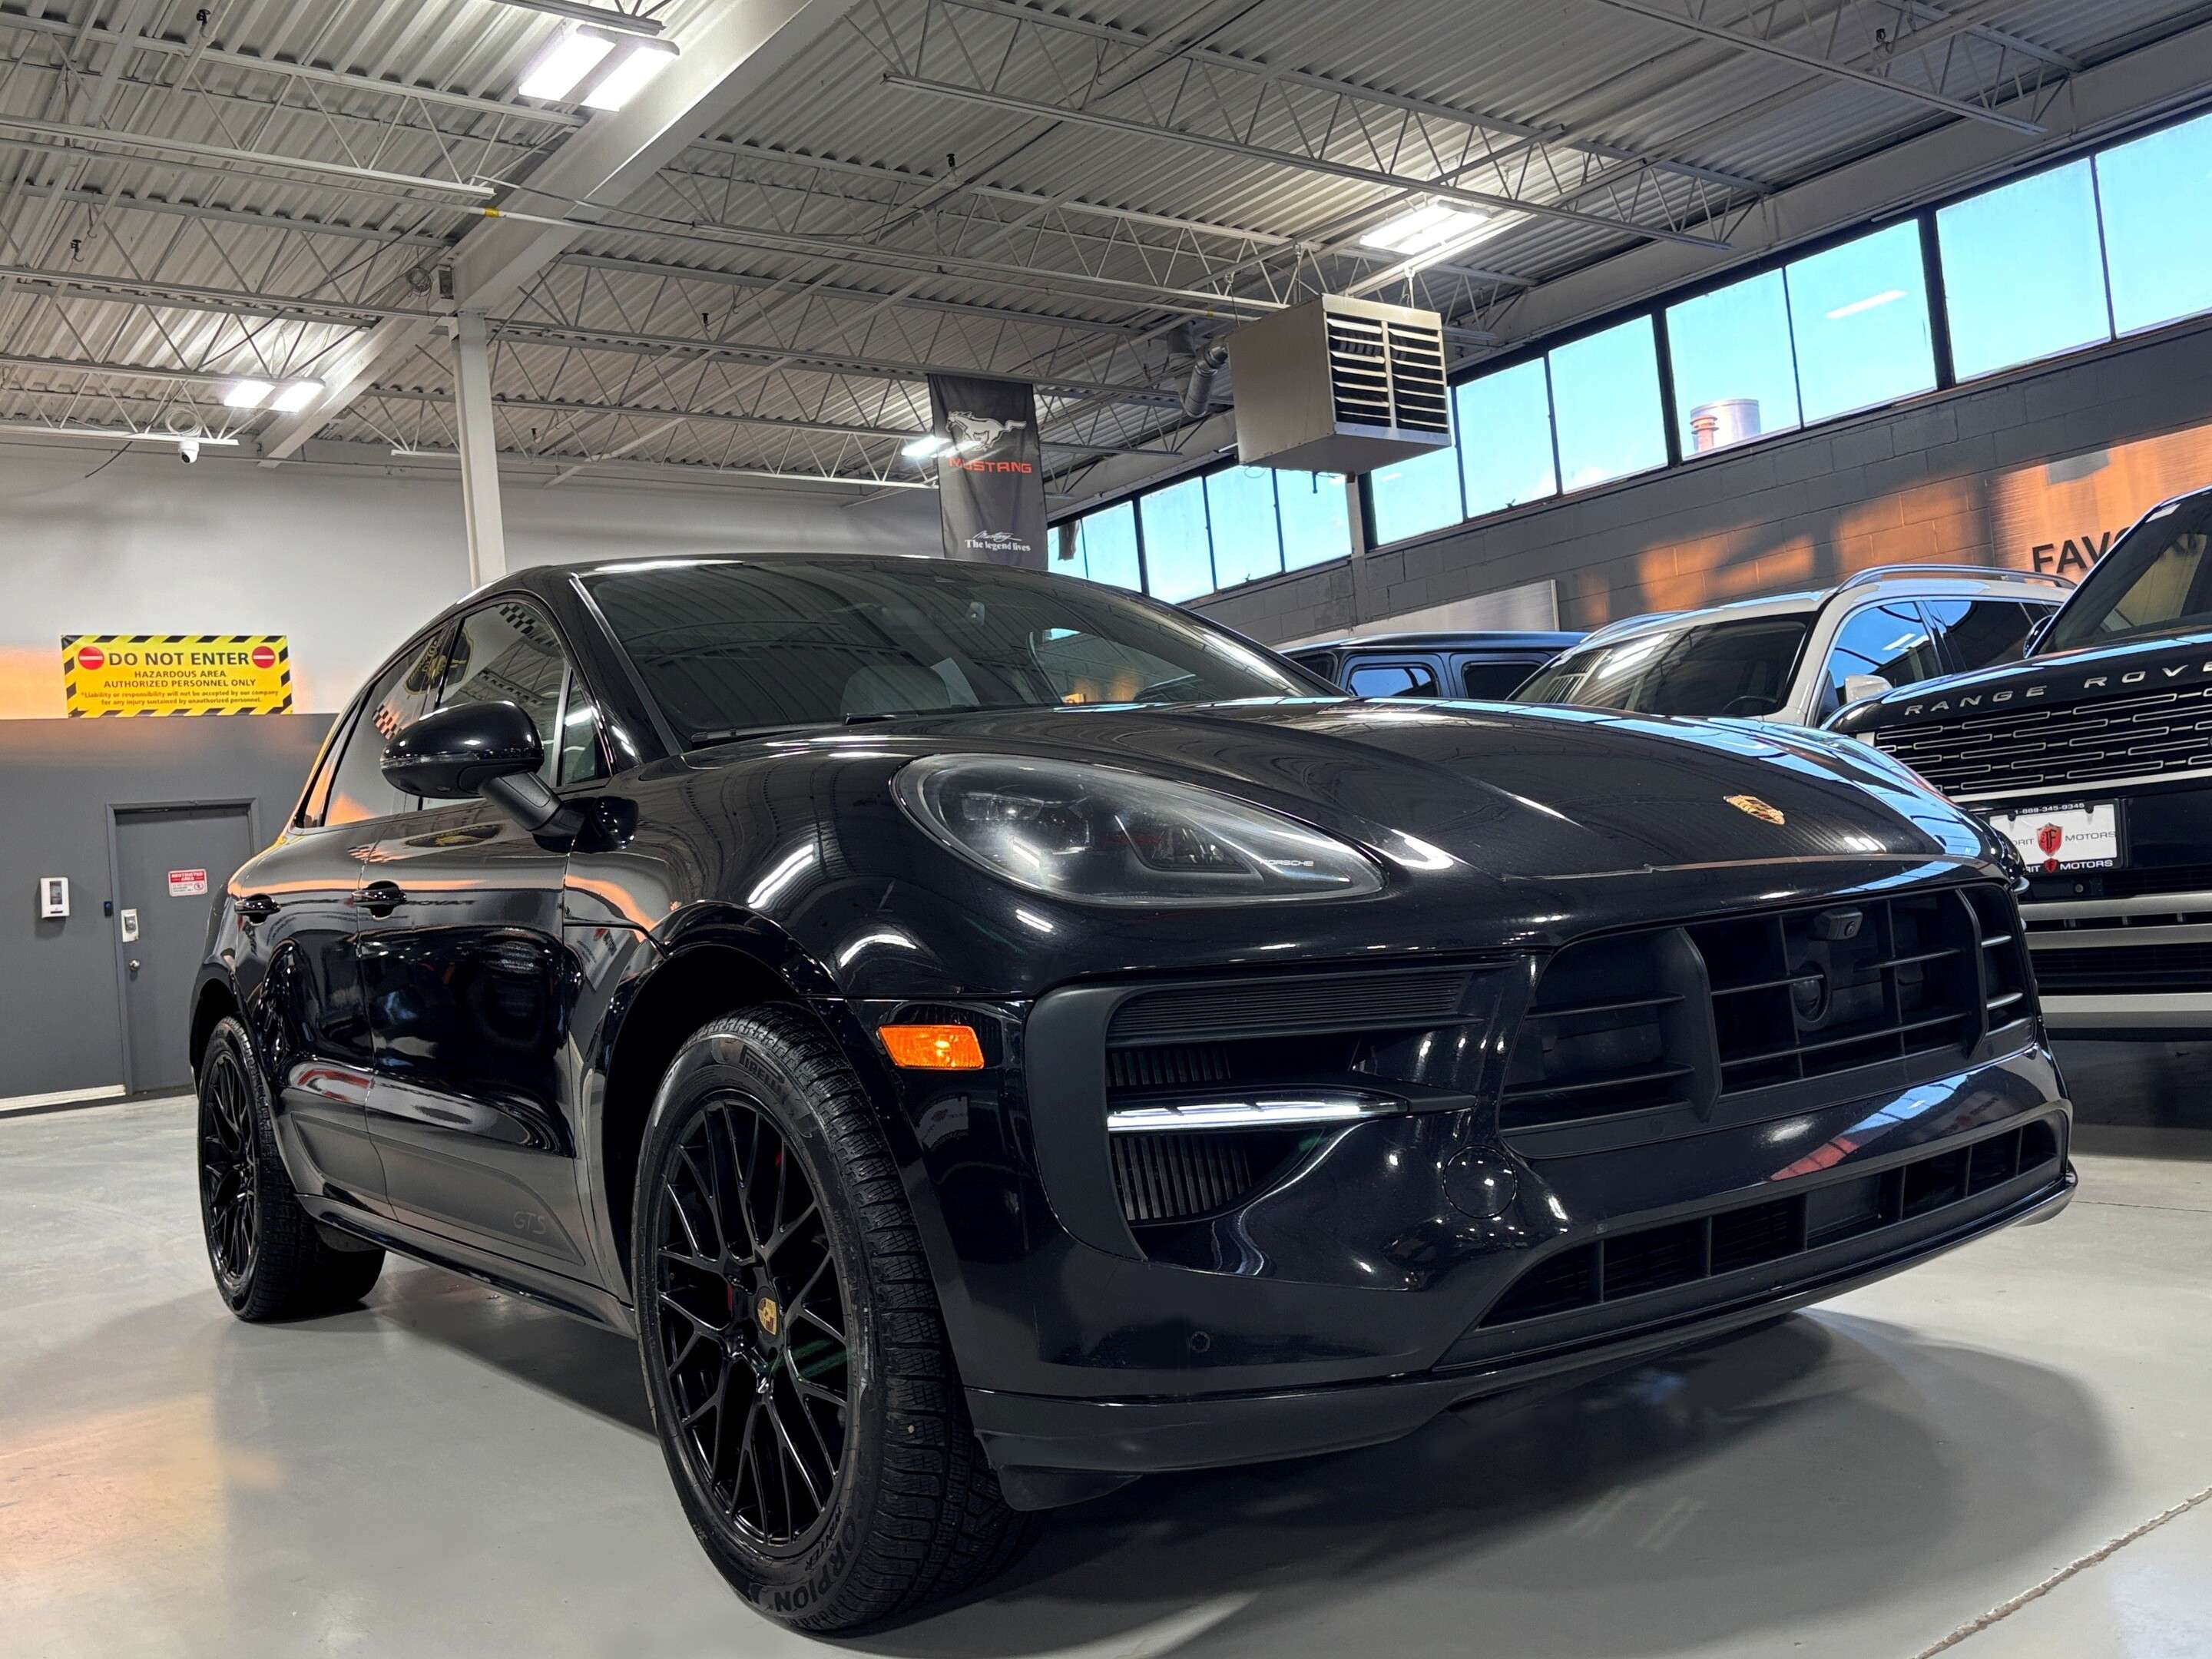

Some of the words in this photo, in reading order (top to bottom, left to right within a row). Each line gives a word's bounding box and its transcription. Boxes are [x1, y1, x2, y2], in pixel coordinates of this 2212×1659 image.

[949, 456, 1032, 474] MUSTANG
[965, 539, 983, 548] The
[985, 541, 1012, 551] legend
[1012, 542, 1031, 551] lives
[109, 652, 137, 666] DO
[145, 652, 184, 666] NOT
[191, 652, 249, 665] ENTER
[104, 680, 168, 688] AUTHORIZED
[1905, 686, 2048, 717] RANGE
[2065, 830, 2116, 842] MOTORS
[2060, 859, 2113, 871] MOTORS
[513, 1210, 548, 1235] GTS
